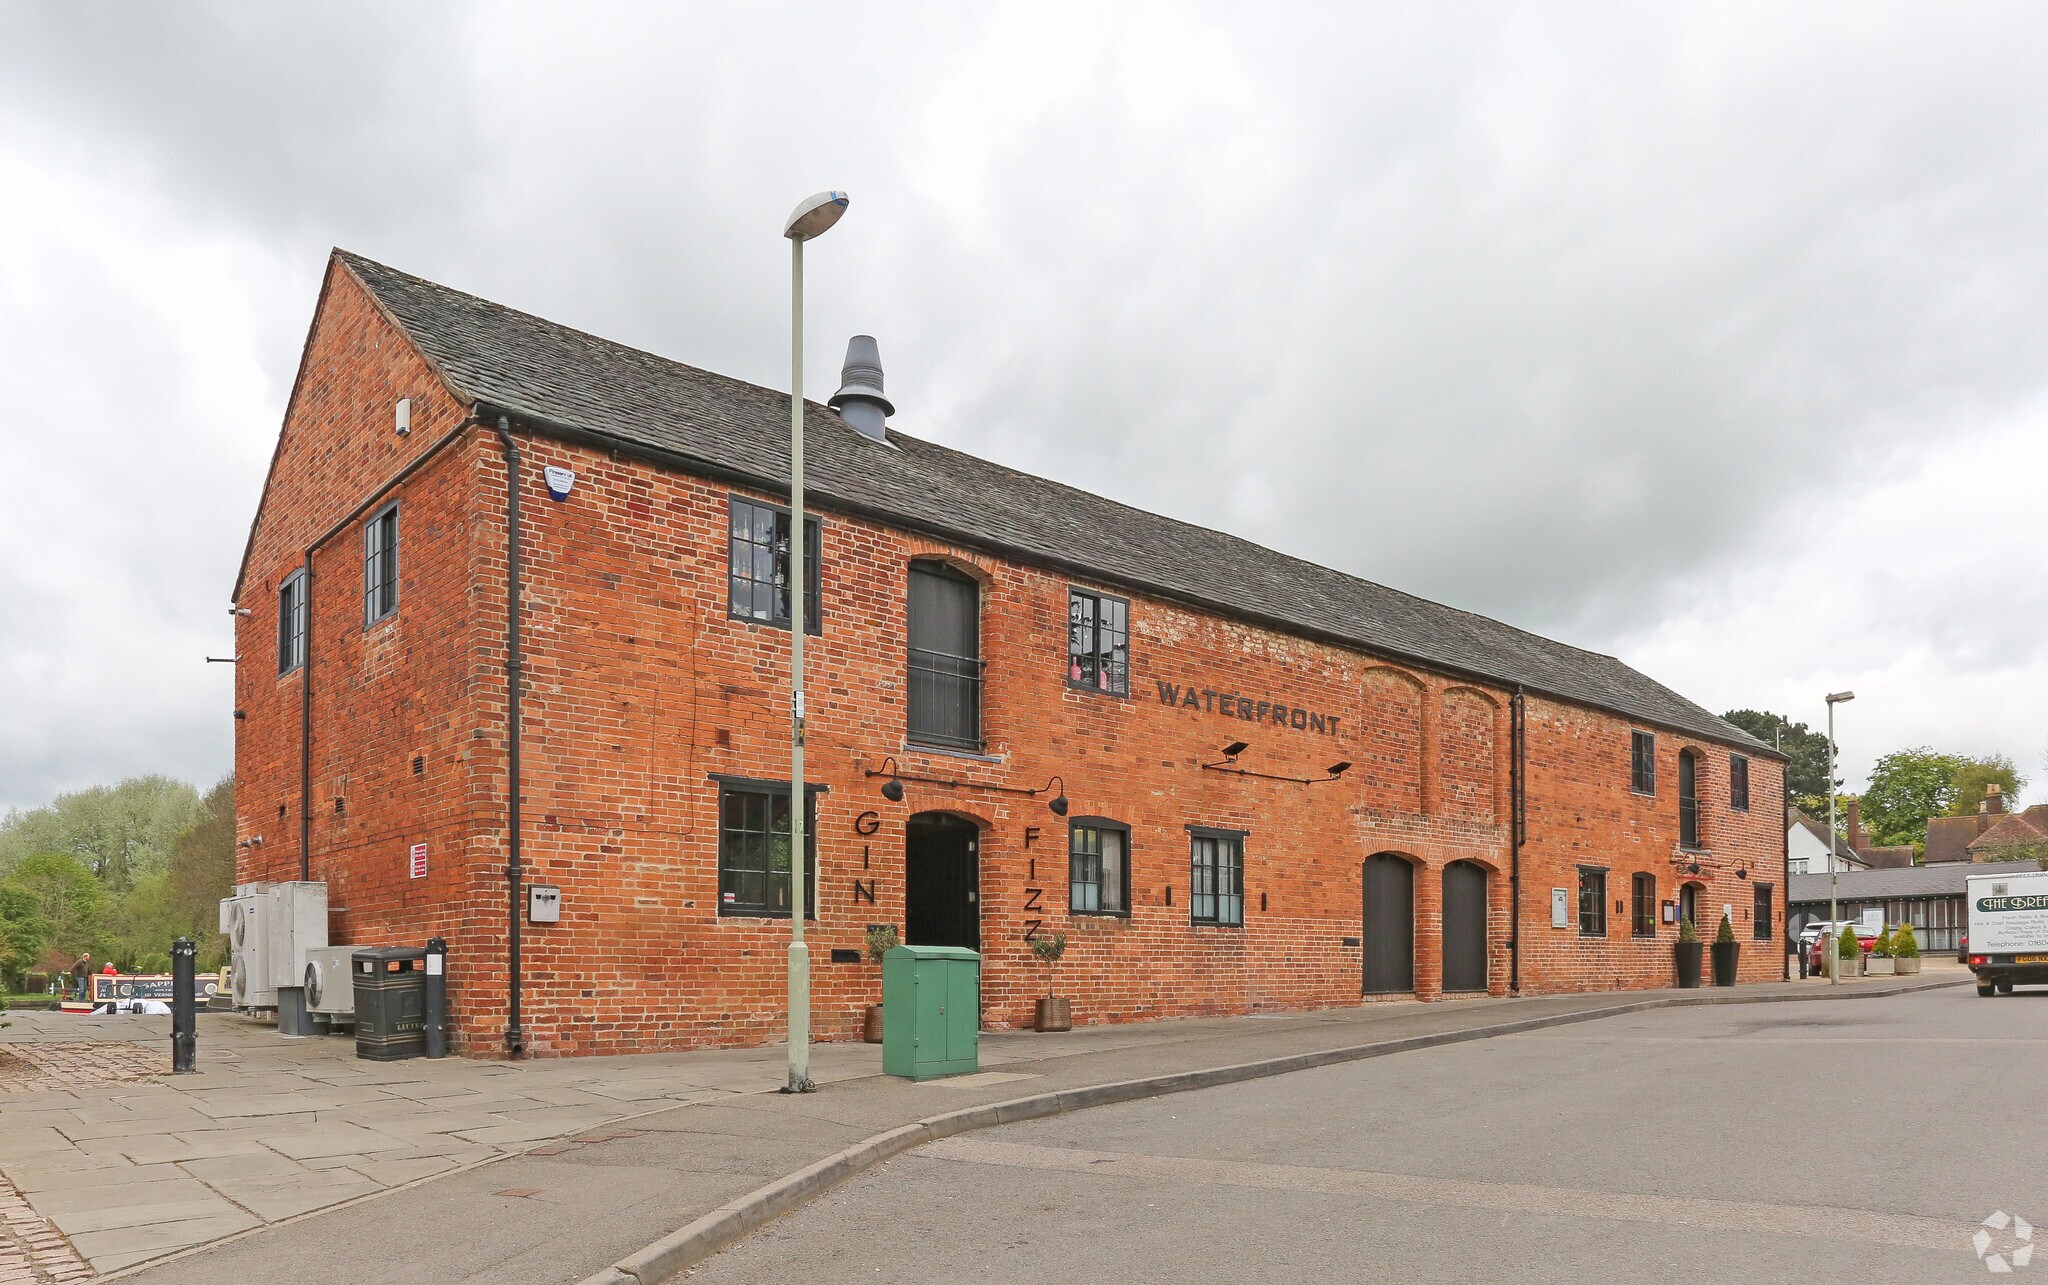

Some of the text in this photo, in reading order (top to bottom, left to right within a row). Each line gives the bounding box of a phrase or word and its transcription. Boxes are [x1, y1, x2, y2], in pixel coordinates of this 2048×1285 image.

[1157, 680, 1341, 736] WATERFRONT
[855, 811, 880, 904] GIN
[1024, 826, 1043, 942] FIZZ
[1982, 898, 2007, 910] THE
